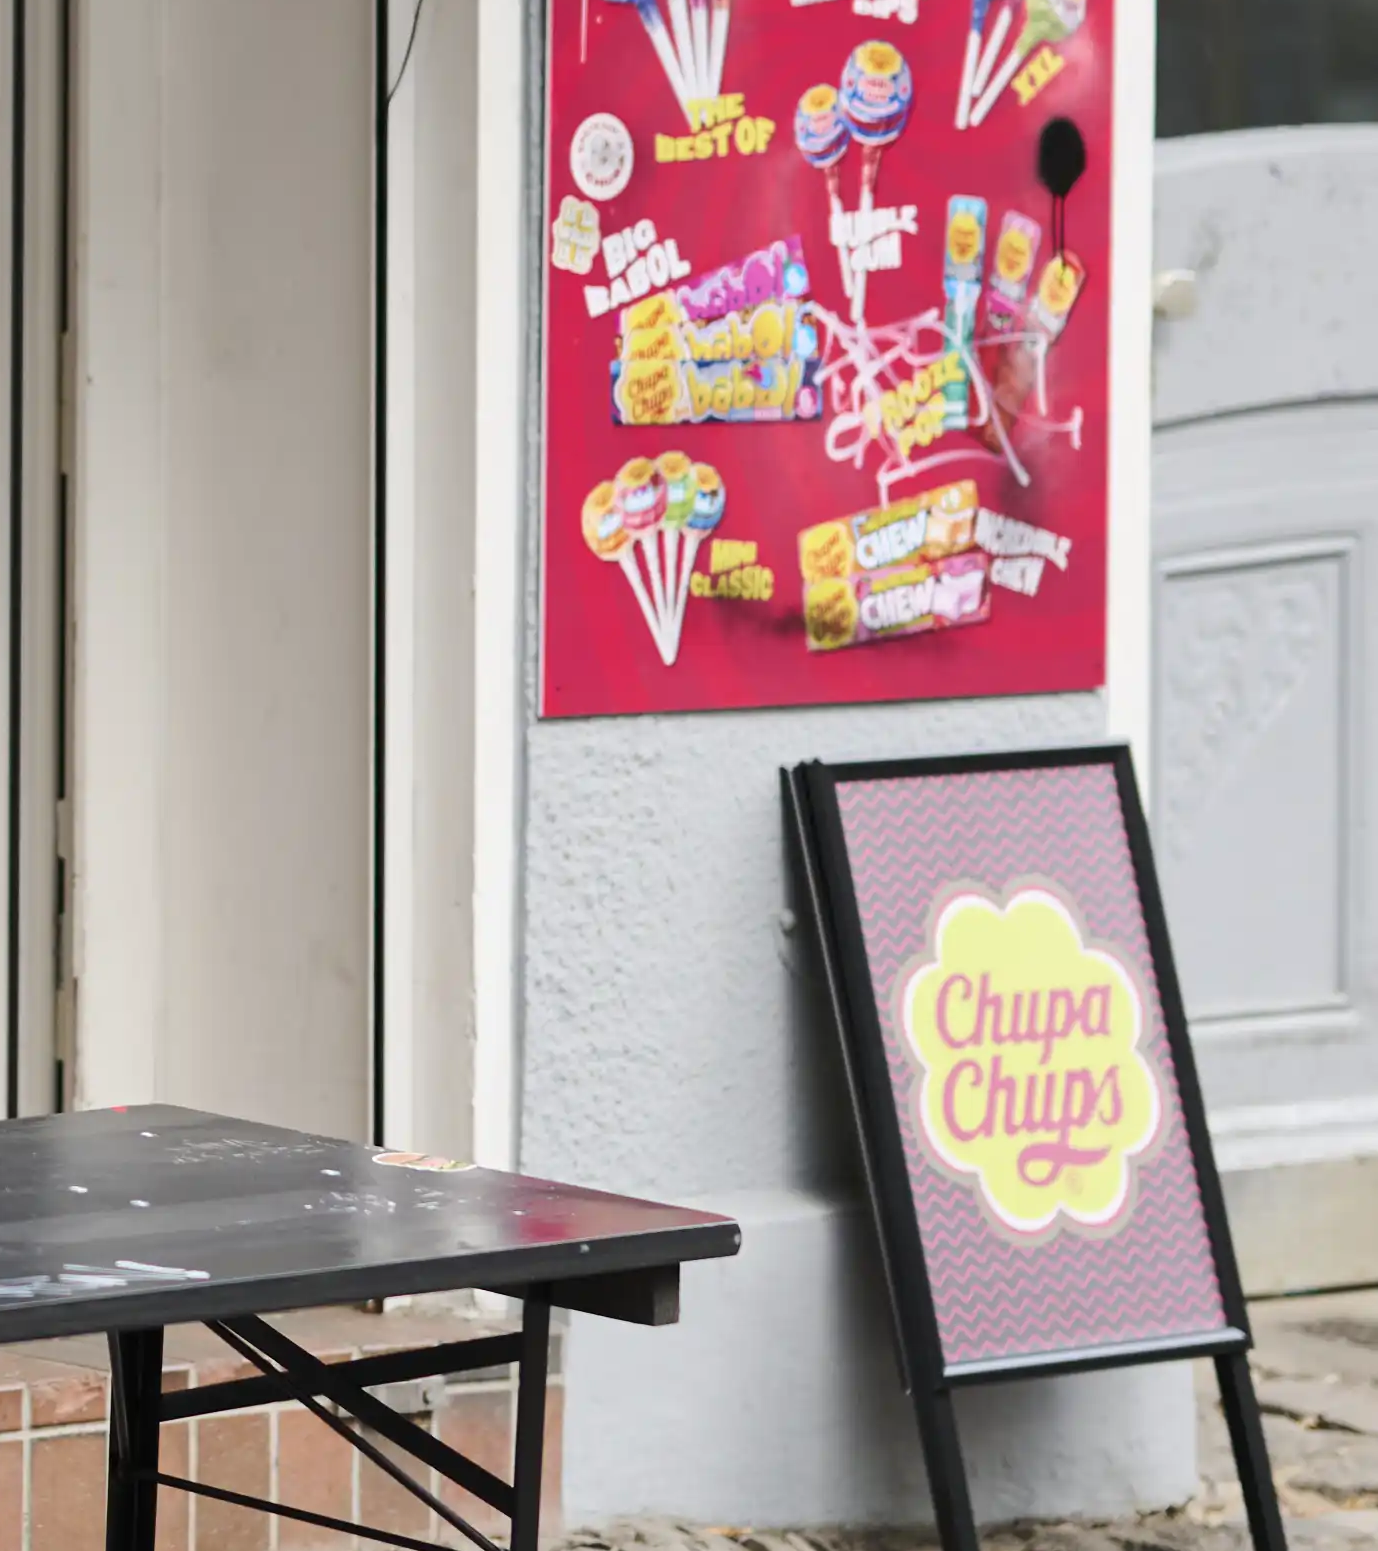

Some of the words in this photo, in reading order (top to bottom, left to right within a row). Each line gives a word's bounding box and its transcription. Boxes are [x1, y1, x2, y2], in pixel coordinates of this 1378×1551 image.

[654, 120, 734, 164] BEST
[734, 115, 776, 156] OF
[685, 92, 746, 134] THE
[583, 237, 692, 319] BABOL
[601, 218, 658, 280] BIG
[690, 565, 775, 602] CLASSIC
[935, 971, 1113, 1066] Chupa
[943, 1055, 1124, 1187] Chups
